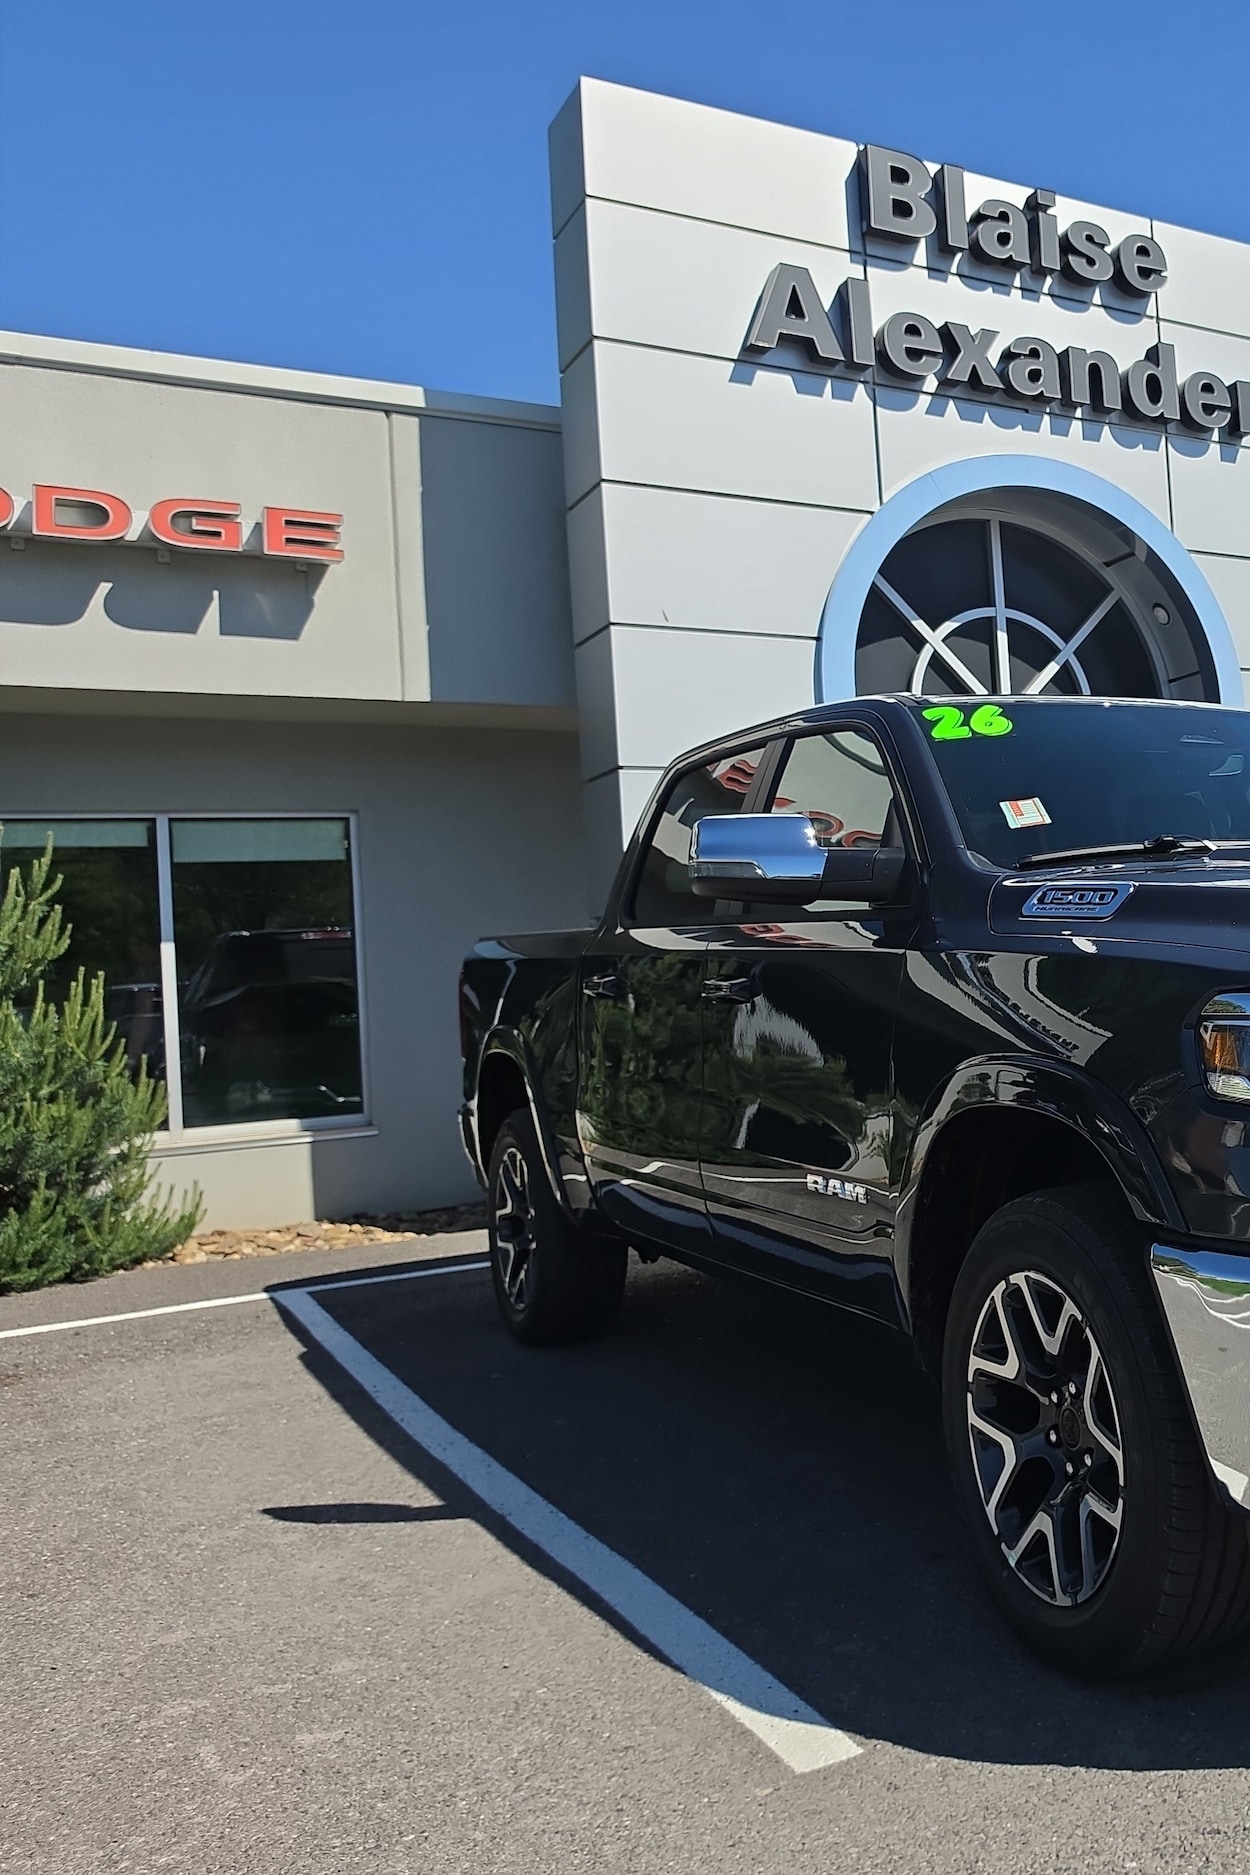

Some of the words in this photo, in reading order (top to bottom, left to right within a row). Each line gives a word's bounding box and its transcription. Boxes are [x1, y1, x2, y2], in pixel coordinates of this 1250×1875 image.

[859, 144, 1168, 294] Blaise
[0, 483, 345, 562] DGE
[920, 704, 1014, 742] 26
[1043, 890, 1115, 904] 1500
[806, 1173, 868, 1205] RAM
